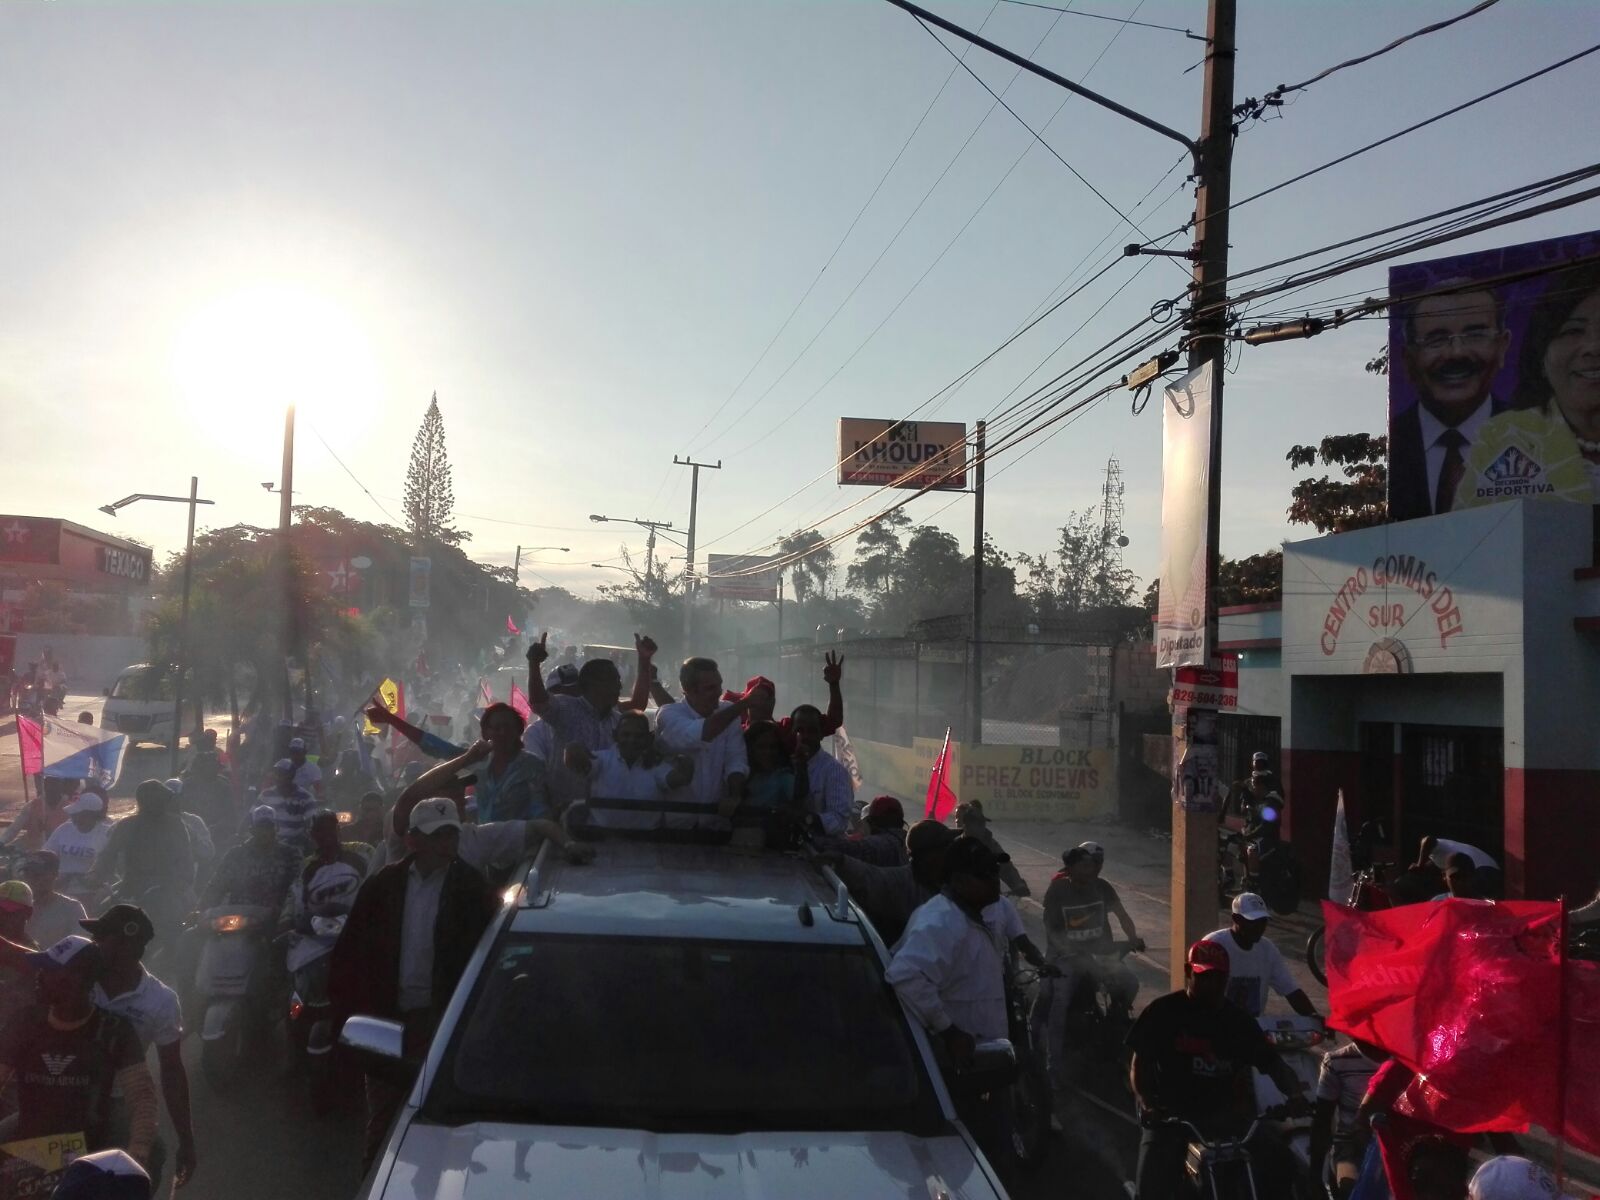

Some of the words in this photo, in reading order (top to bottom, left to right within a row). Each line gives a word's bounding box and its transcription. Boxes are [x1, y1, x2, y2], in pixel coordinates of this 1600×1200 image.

[855, 441, 951, 464] KHOURY
[1477, 483, 1554, 497] DEPORTIVA
[105, 549, 144, 579] TEXACO
[1321, 567, 1368, 656] CENTRO
[1372, 554, 1437, 599] GOMAS
[1431, 587, 1463, 650] DEL
[1369, 604, 1404, 628] SUR
[1160, 632, 1203, 656] Diputado
[1021, 749, 1091, 766] BLOCK
[963, 765, 1020, 787] PEREZ
[1030, 768, 1099, 789] CUEVAS
